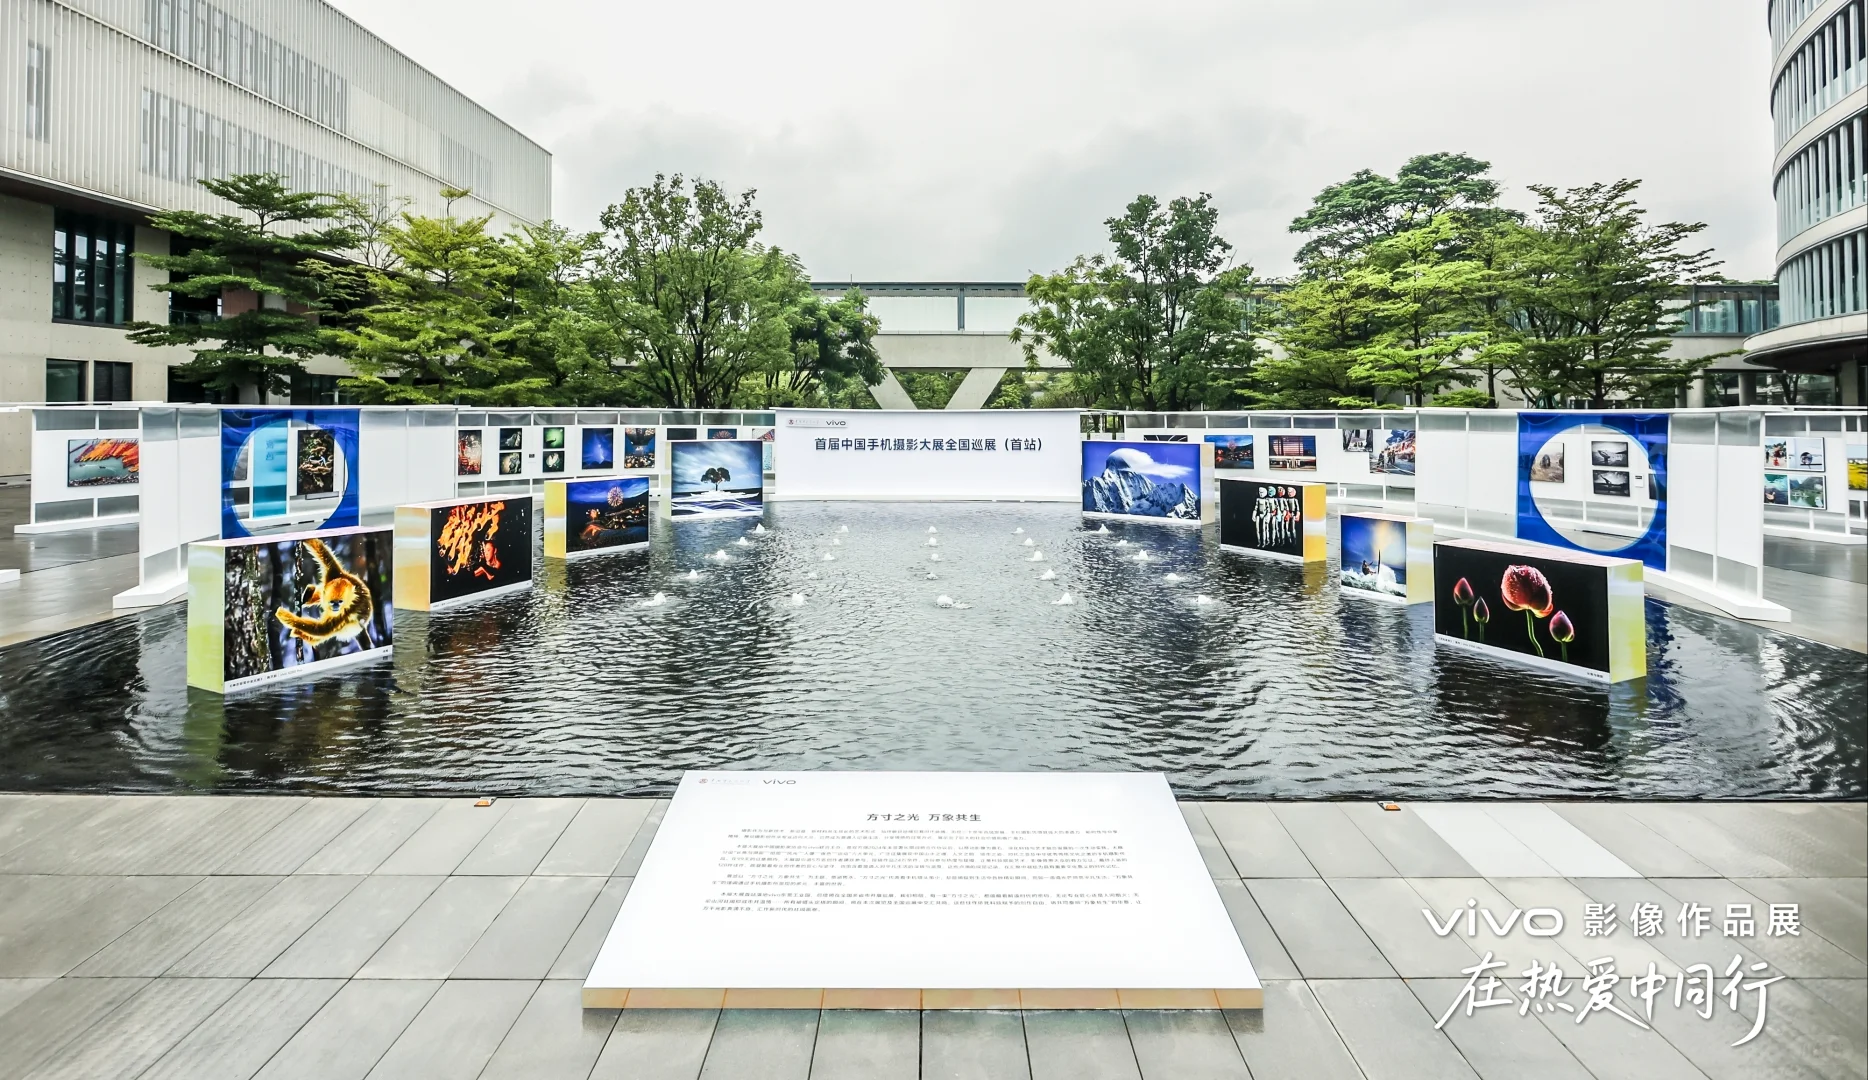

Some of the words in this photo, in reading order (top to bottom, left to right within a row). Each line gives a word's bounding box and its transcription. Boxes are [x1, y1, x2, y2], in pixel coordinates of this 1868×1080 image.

[825, 419, 847, 427] vivo
[867, 813, 920, 822] 方寸之光
[928, 813, 982, 822] 万象共生
